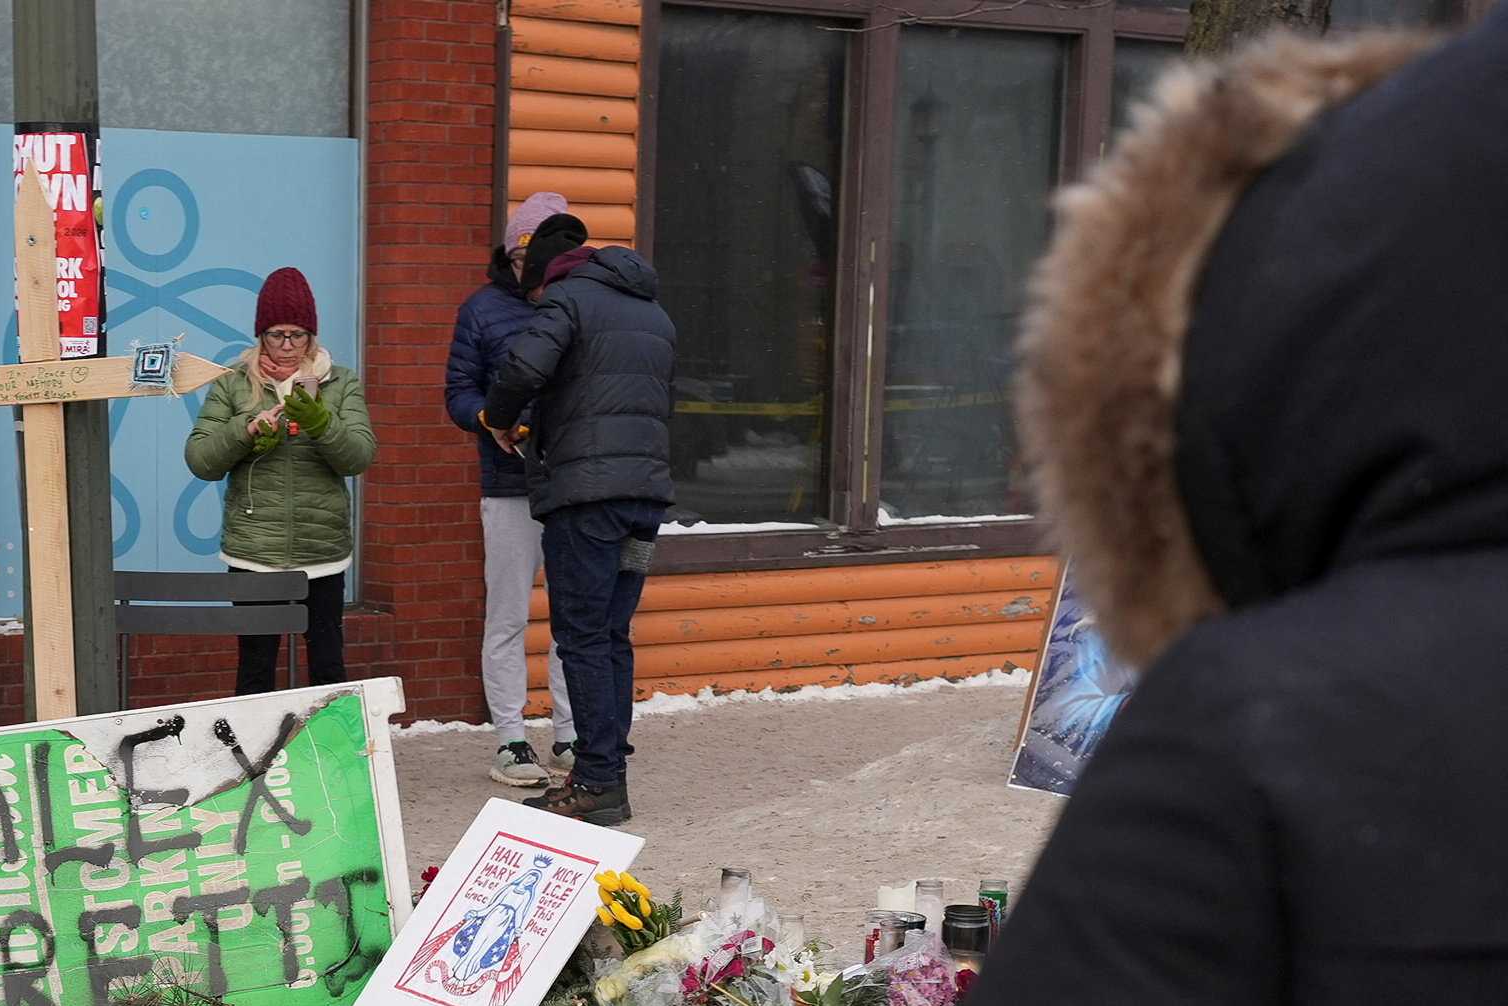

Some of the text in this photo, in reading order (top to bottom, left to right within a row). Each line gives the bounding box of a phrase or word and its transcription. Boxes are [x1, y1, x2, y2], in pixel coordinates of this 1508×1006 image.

[14, 135, 76, 172] HUT
[56, 257, 84, 279] RK
[57, 281, 78, 298] OL
[490, 845, 524, 869] HAIL
[479, 862, 517, 883] MARY
[552, 866, 583, 886] KICK
[464, 887, 488, 905] Grace
[533, 905, 555, 922] This
[524, 918, 549, 937] Place
